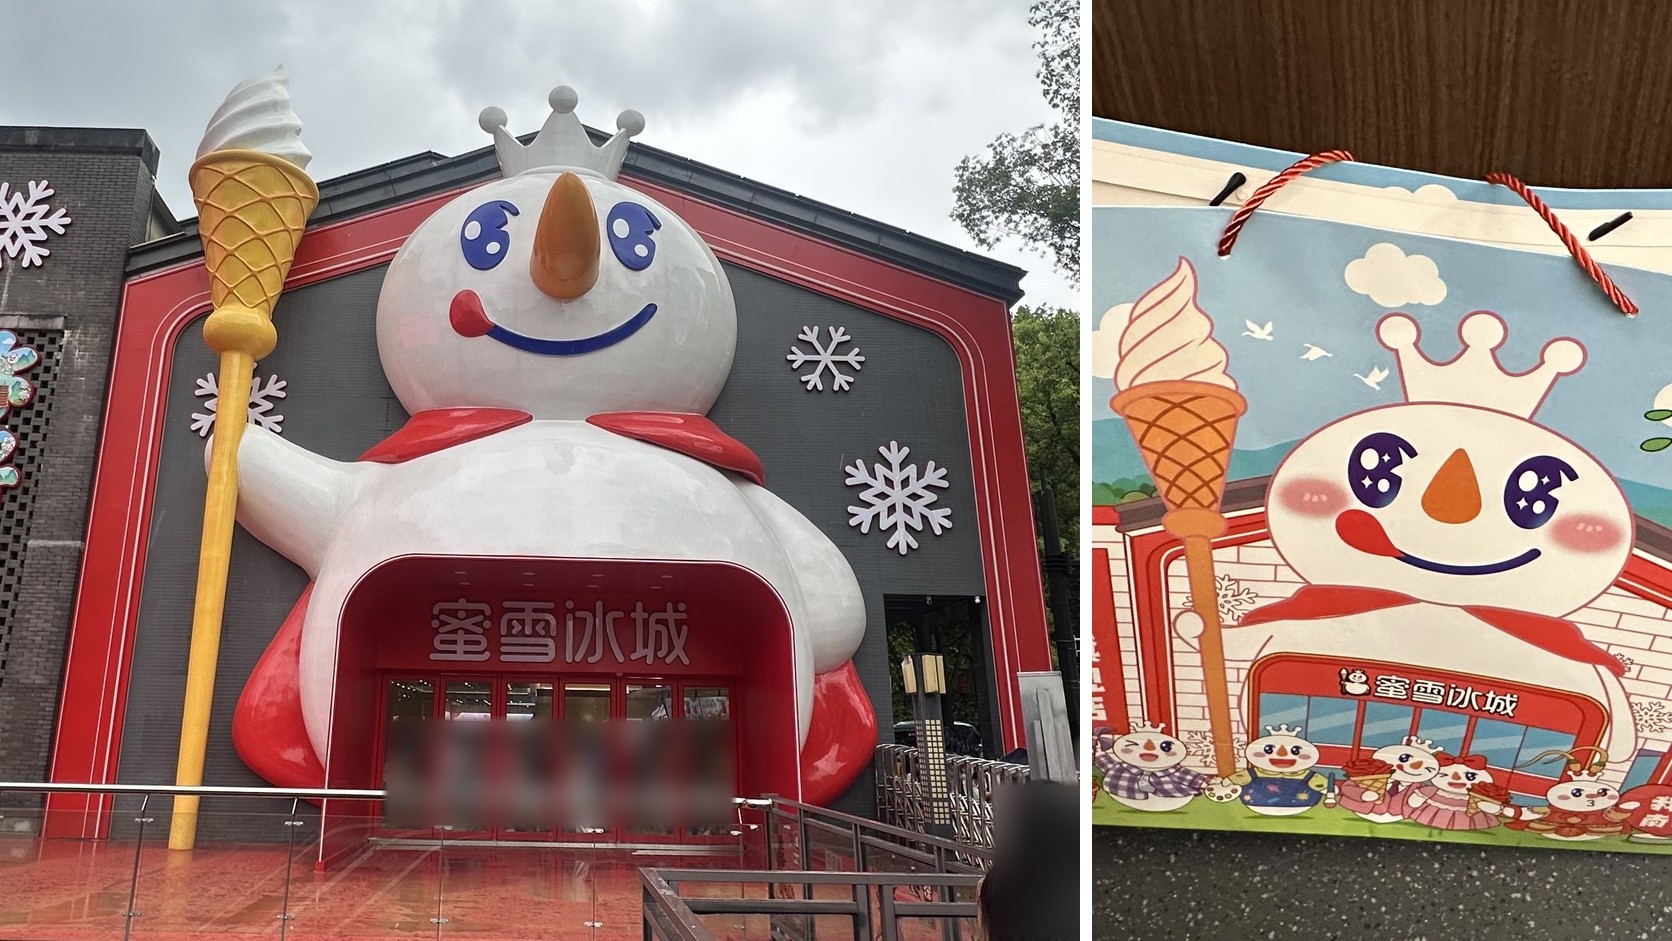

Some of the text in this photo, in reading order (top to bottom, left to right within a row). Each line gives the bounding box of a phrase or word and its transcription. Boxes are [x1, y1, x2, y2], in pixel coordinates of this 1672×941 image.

[429, 599, 690, 665] 蜜雪冰城
[1374, 675, 1519, 717] 蜜雪冰城
